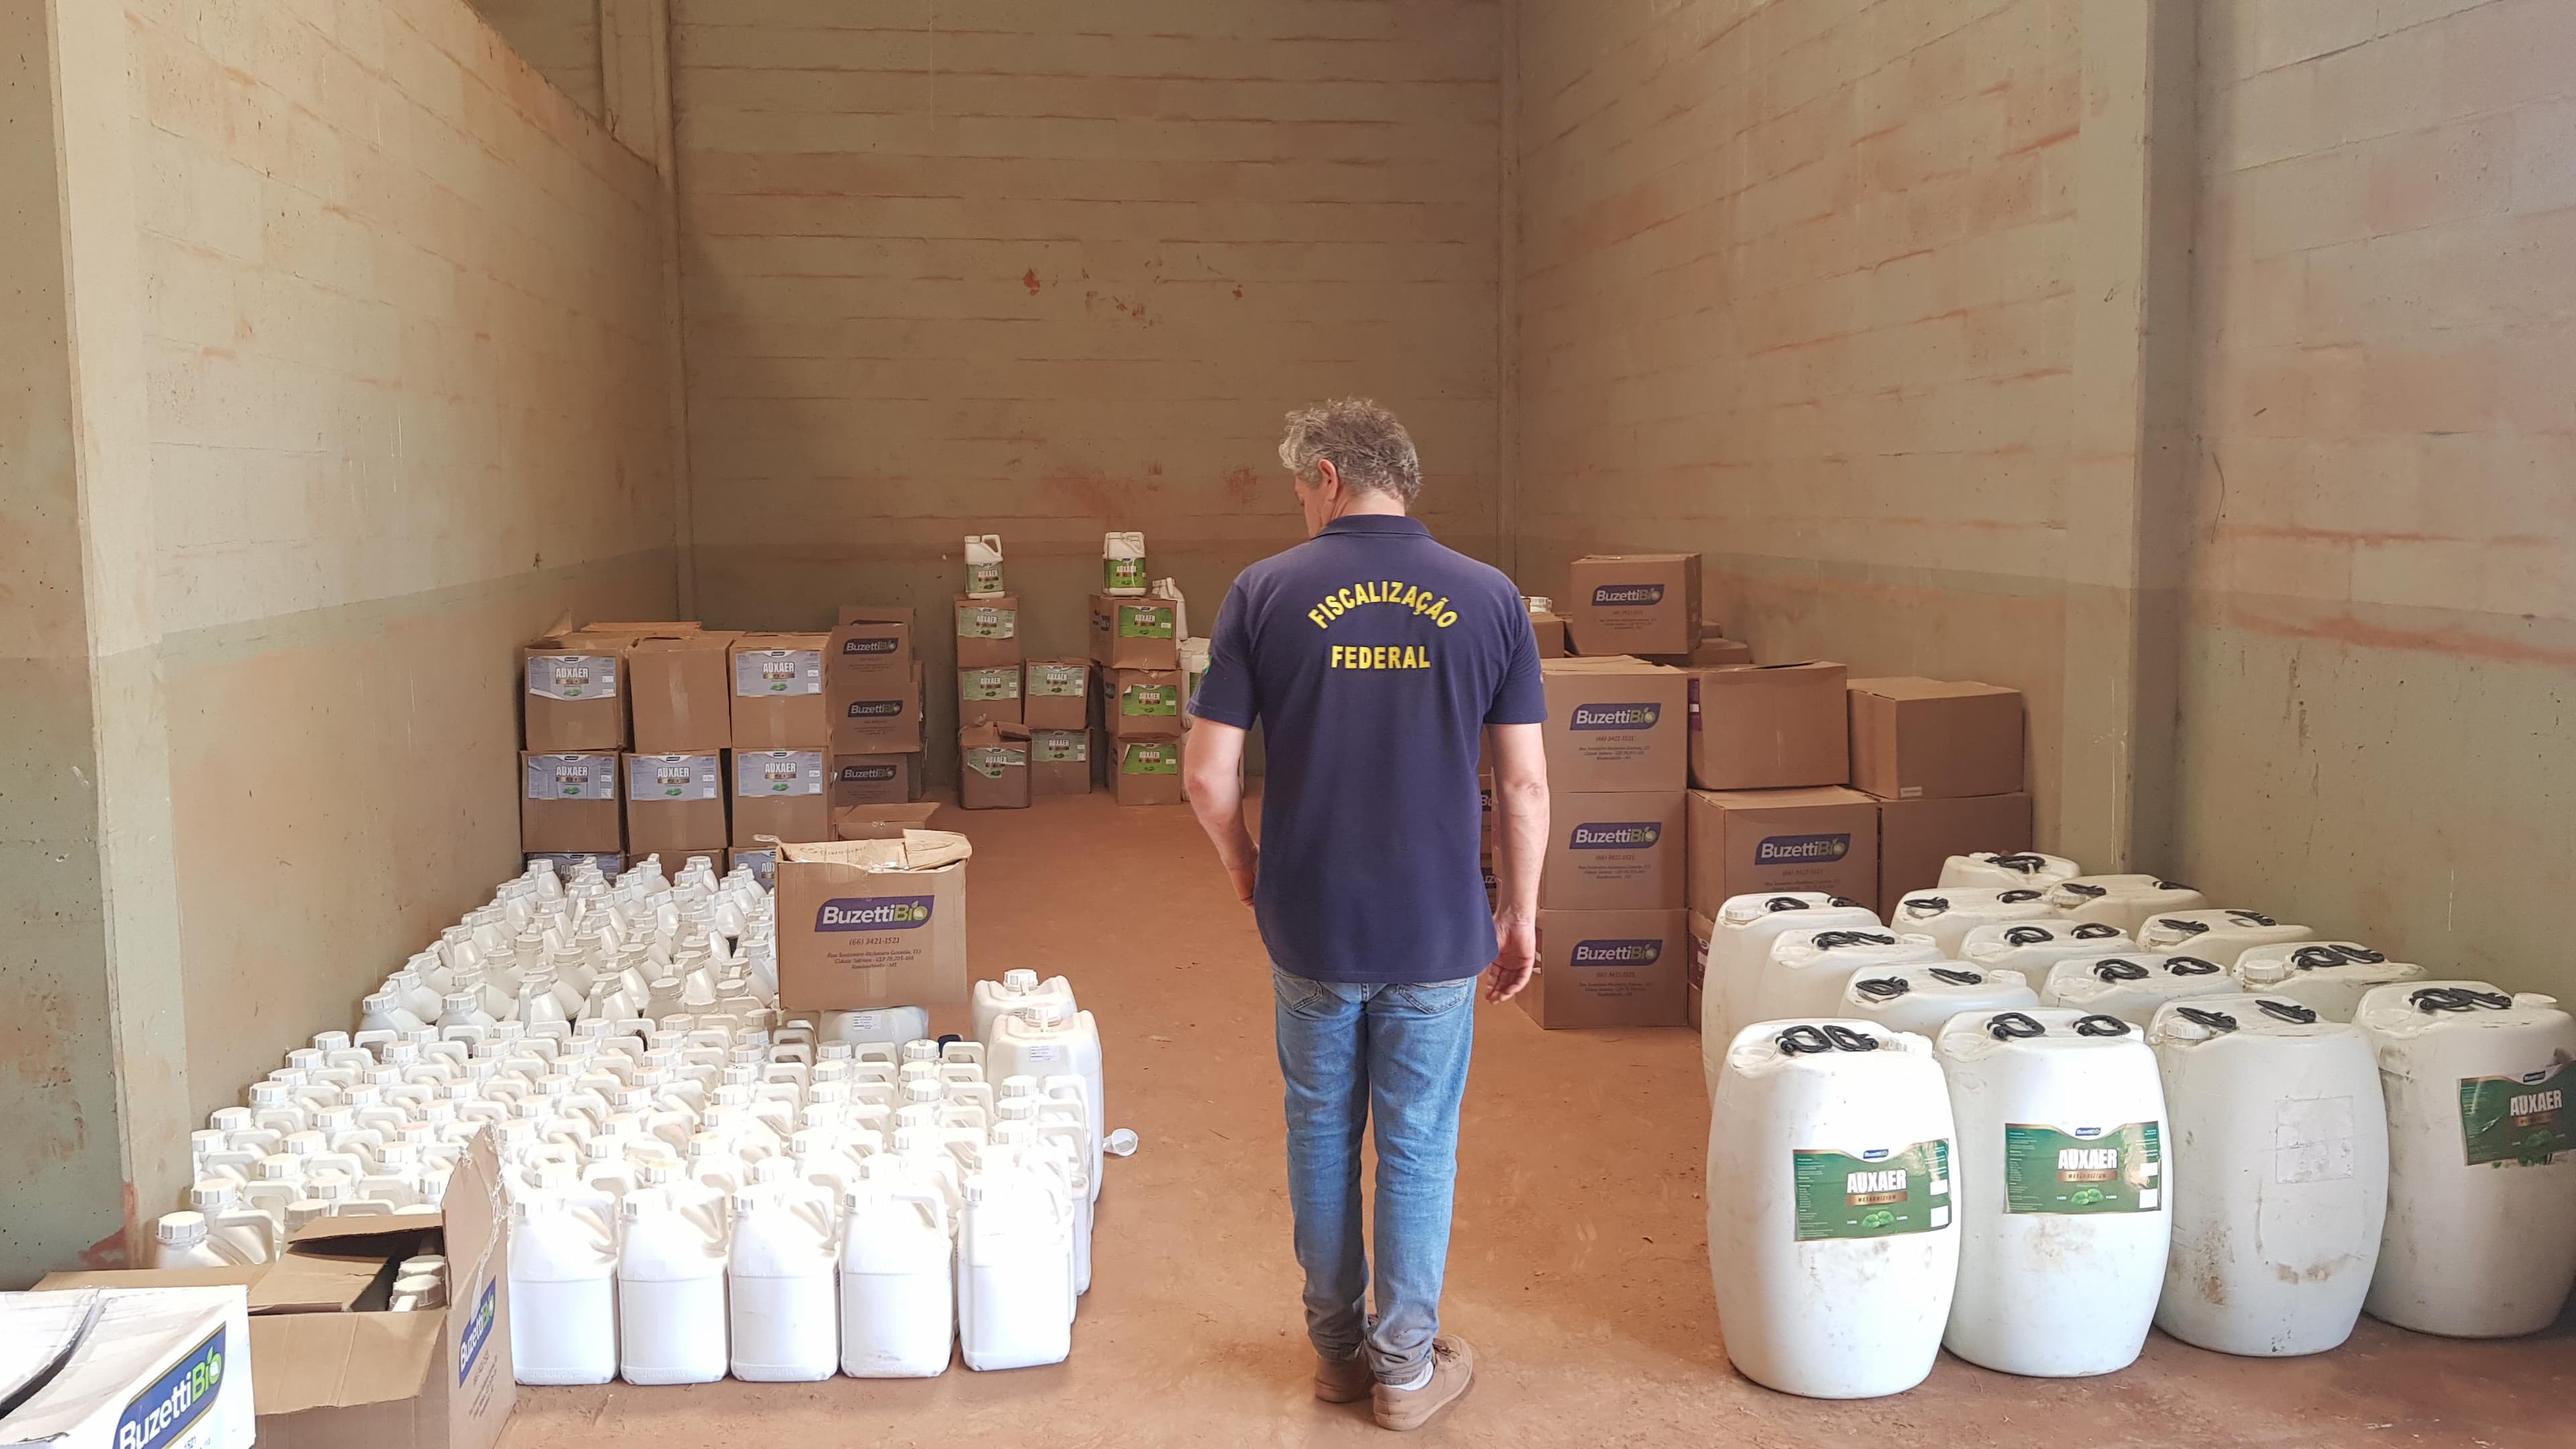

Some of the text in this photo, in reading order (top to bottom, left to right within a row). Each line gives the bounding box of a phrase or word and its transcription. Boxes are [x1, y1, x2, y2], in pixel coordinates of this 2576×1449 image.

[1596, 588, 1661, 602] BuzettiBio
[1307, 580, 1458, 630] FISCALIZAÇÃO
[1331, 645, 1431, 669] FEDERAL
[555, 667, 590, 678] AUXAER
[763, 661, 794, 673] AUXAER
[1046, 673, 1067, 681] AUXAER
[1576, 706, 1656, 724] BuzettiBio
[556, 766, 588, 775] AUXAER
[657, 767, 690, 777] AUXAER
[765, 762, 796, 773] AUXAER
[1576, 826, 1657, 843] BuzettiBio
[1761, 837, 1845, 859] BuzettiBio
[822, 901, 928, 924] BuzettiBio
[865, 937, 900, 945] 3421-1521
[1576, 944, 1658, 961] BuzettiBio
[2510, 1089, 2563, 1116] AUXAER
[2057, 1148, 2117, 1170] AUXAER
[1847, 1169, 1907, 1193] AUXAER
[119, 1346, 222, 1449] BuzettiBio
